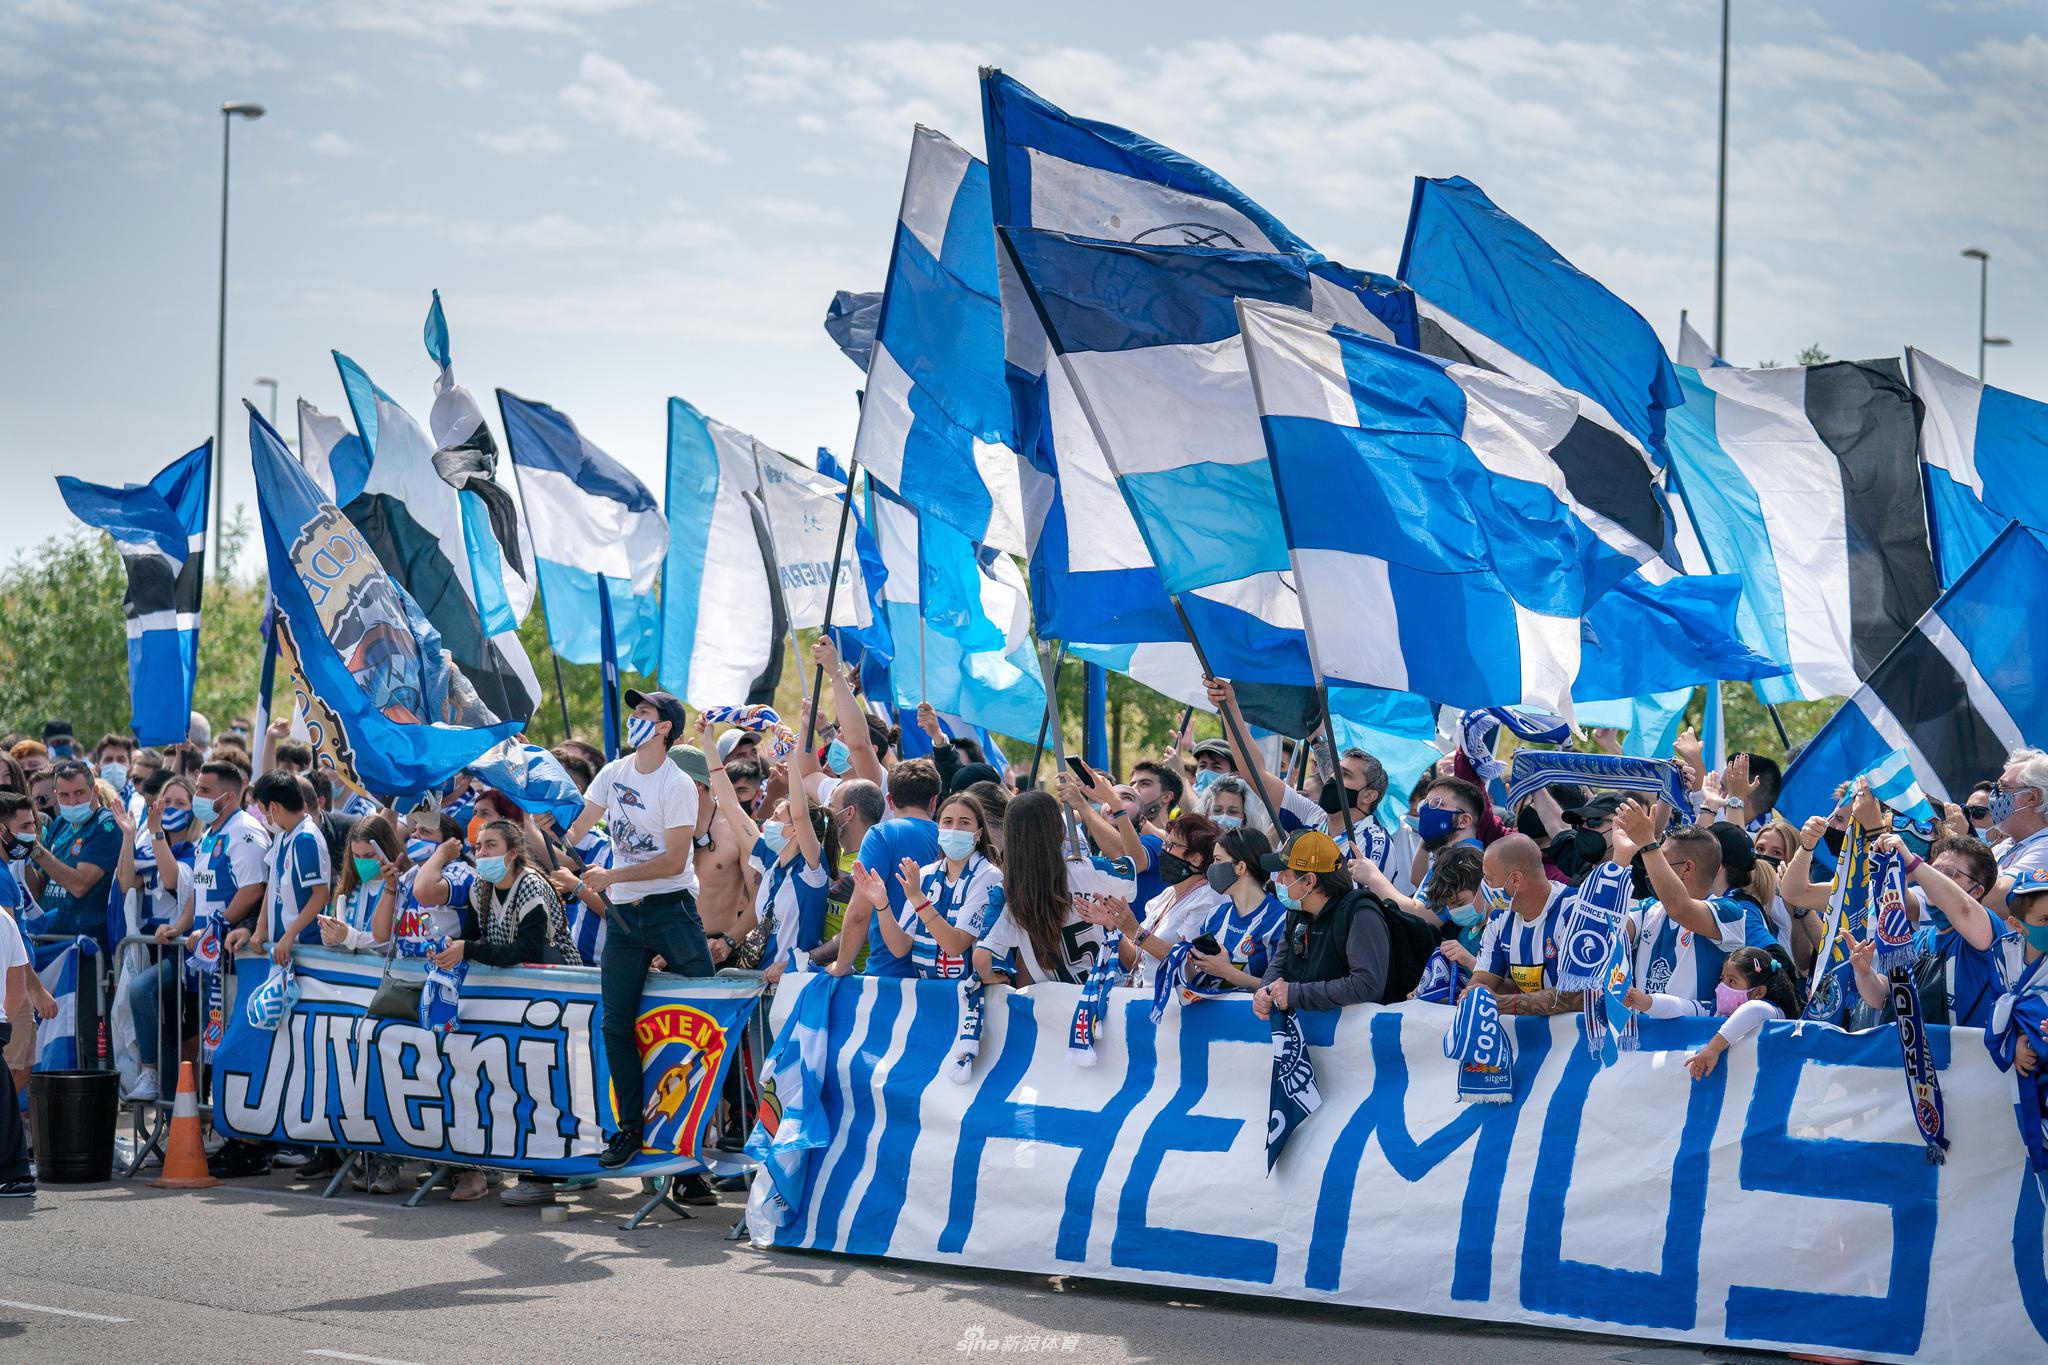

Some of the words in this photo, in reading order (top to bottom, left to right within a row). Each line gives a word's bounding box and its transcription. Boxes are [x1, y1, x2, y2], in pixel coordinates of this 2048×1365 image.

[193, 871, 214, 888] etway
[1579, 903, 1602, 919] SINCE
[1601, 910, 1622, 925] 100
[1484, 1074, 1508, 1085] sitges
[937, 994, 1950, 1356] HEMOS
